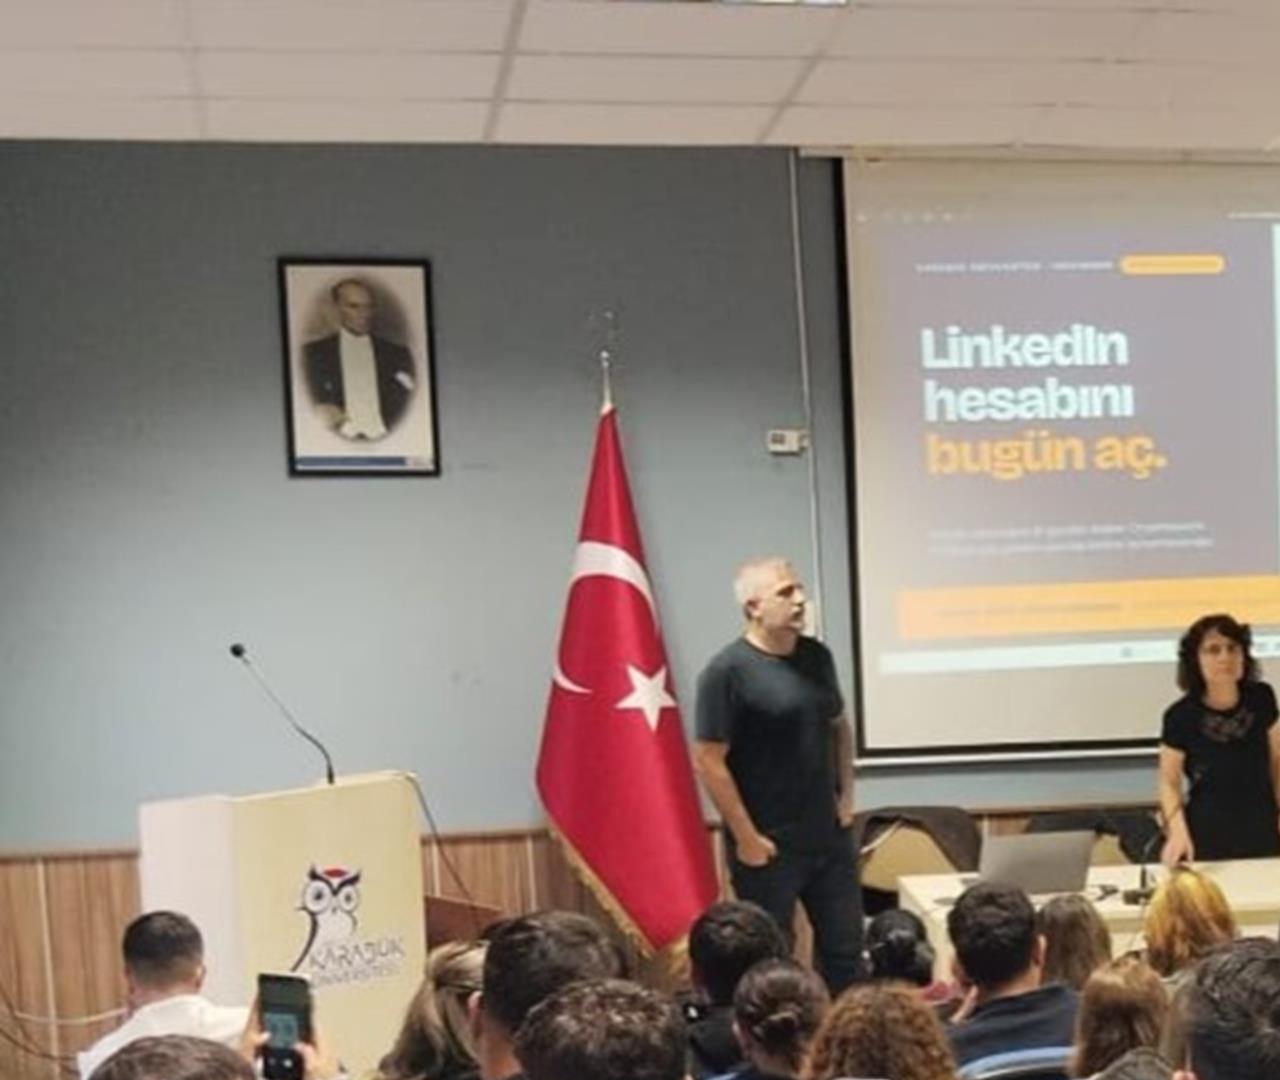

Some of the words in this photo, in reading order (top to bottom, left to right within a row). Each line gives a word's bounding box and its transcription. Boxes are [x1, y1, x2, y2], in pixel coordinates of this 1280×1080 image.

[920, 323, 1129, 369] LinkedIn
[924, 376, 1135, 422] hesabını
[926, 429, 1085, 480] bugün
[1094, 434, 1168, 480] aç.
